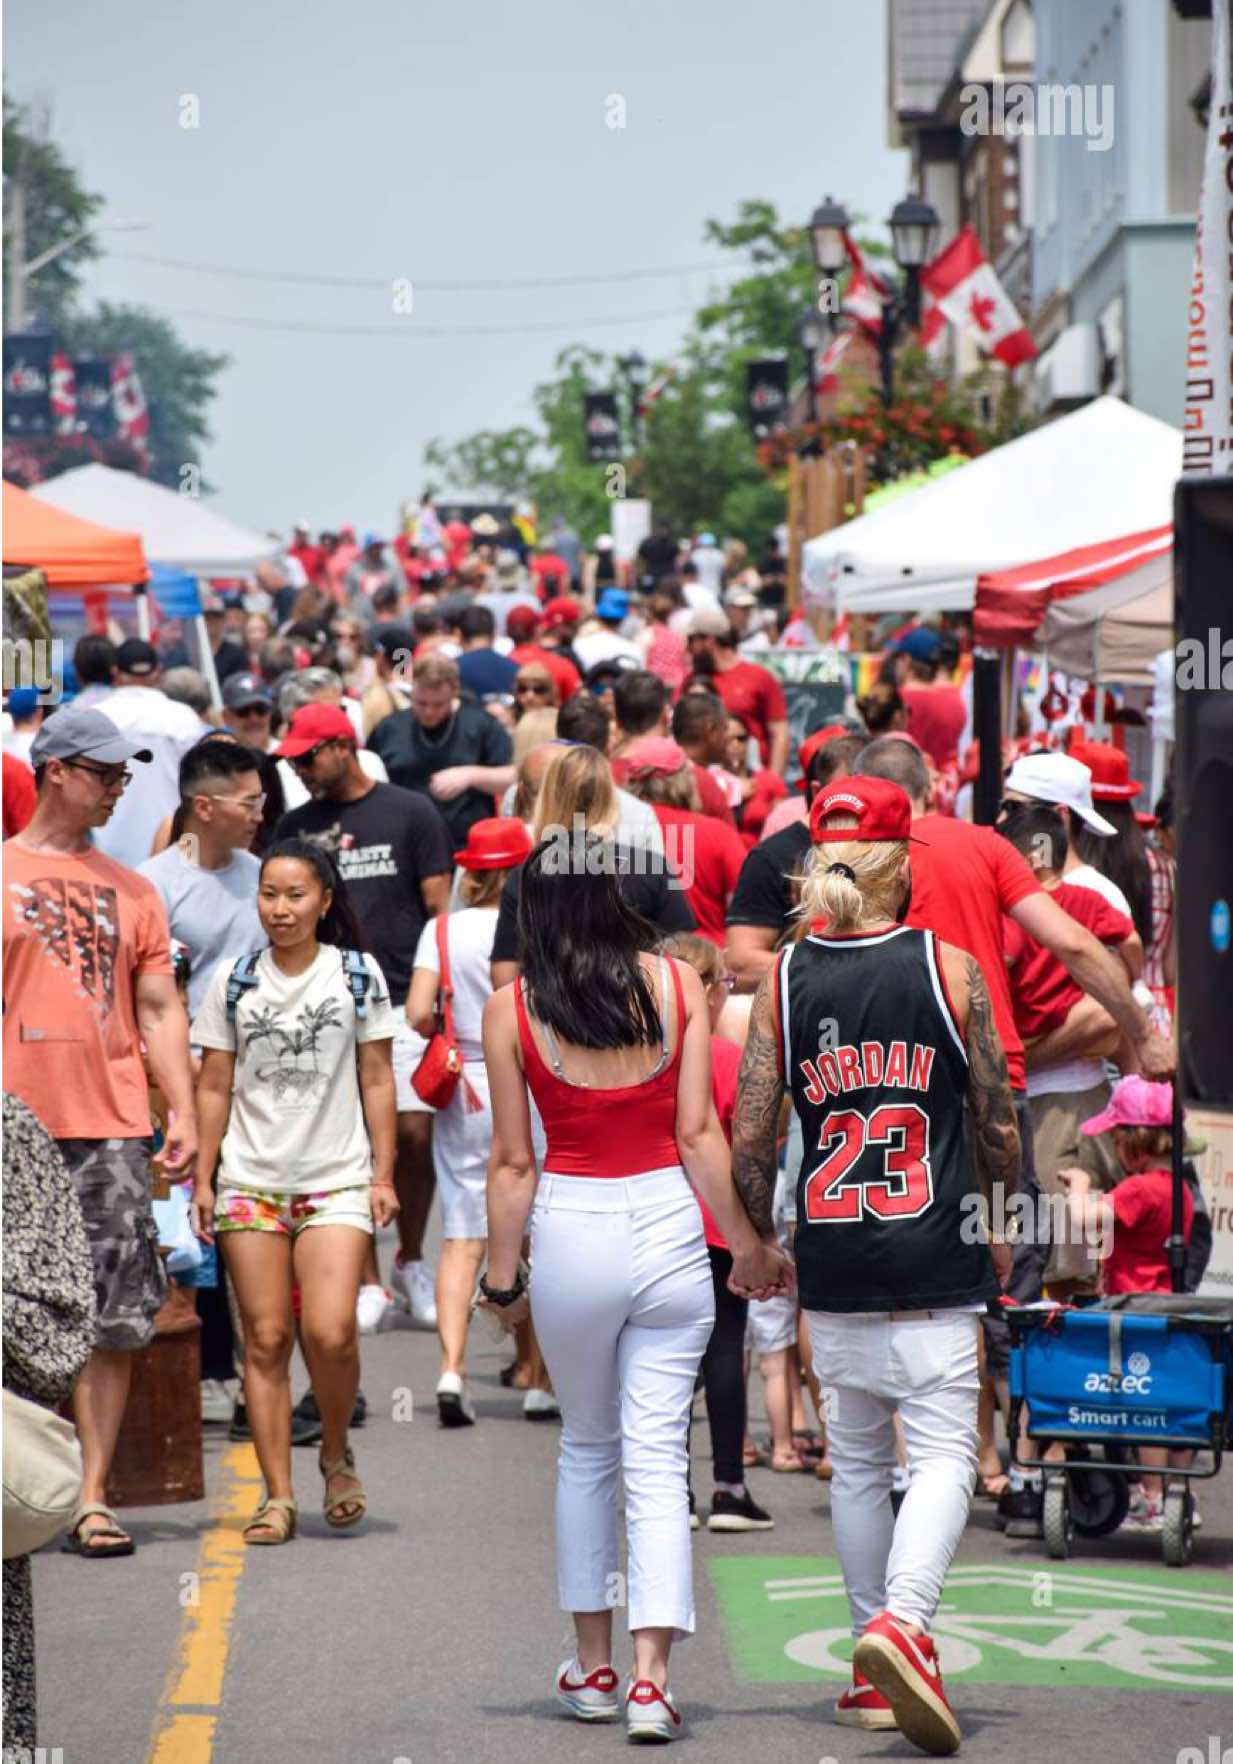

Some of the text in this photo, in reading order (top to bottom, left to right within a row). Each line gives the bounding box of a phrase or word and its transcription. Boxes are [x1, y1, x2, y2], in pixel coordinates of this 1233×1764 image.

[338, 845, 391, 865] PARTY
[800, 1041, 936, 1105] JORDAN
[805, 1104, 934, 1223] 23
[1068, 1406, 1168, 1429] Smart cart
